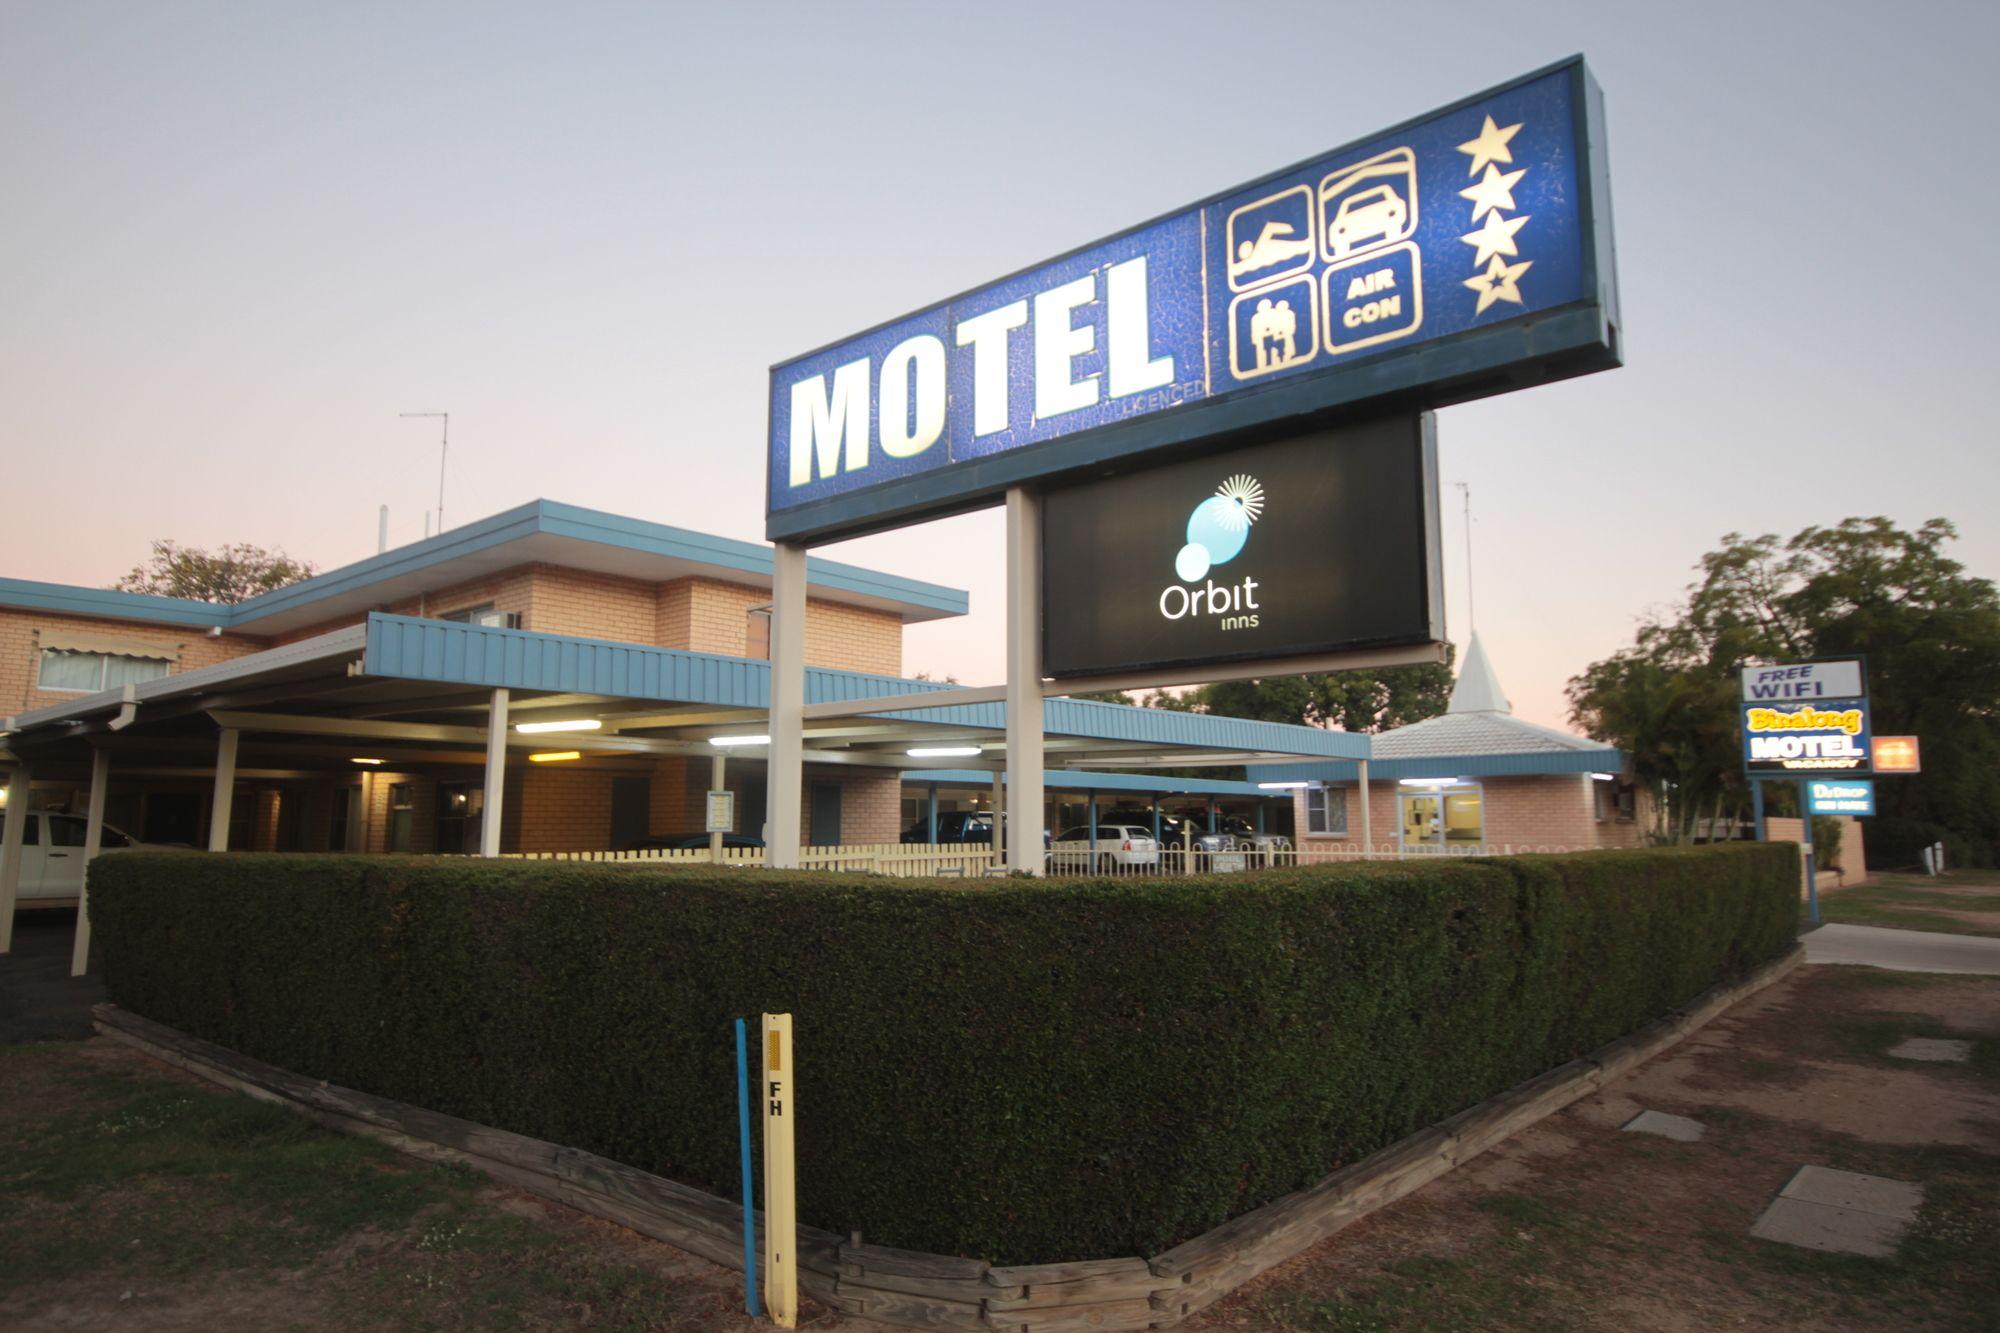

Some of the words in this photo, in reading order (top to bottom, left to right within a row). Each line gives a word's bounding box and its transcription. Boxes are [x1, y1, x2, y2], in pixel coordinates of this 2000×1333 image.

[1347, 268, 1397, 301] AIR
[1343, 295, 1401, 329] CON
[789, 255, 1175, 488] MOTEL
[1121, 379, 1205, 415] LICENCED
[1159, 576, 1260, 620] Orbit
[1221, 614, 1260, 631] inns
[1758, 665, 1814, 684] FREE
[1750, 681, 1823, 699] WIFI
[1747, 707, 1863, 735] Binalong
[1750, 735, 1864, 759] MOTEL
